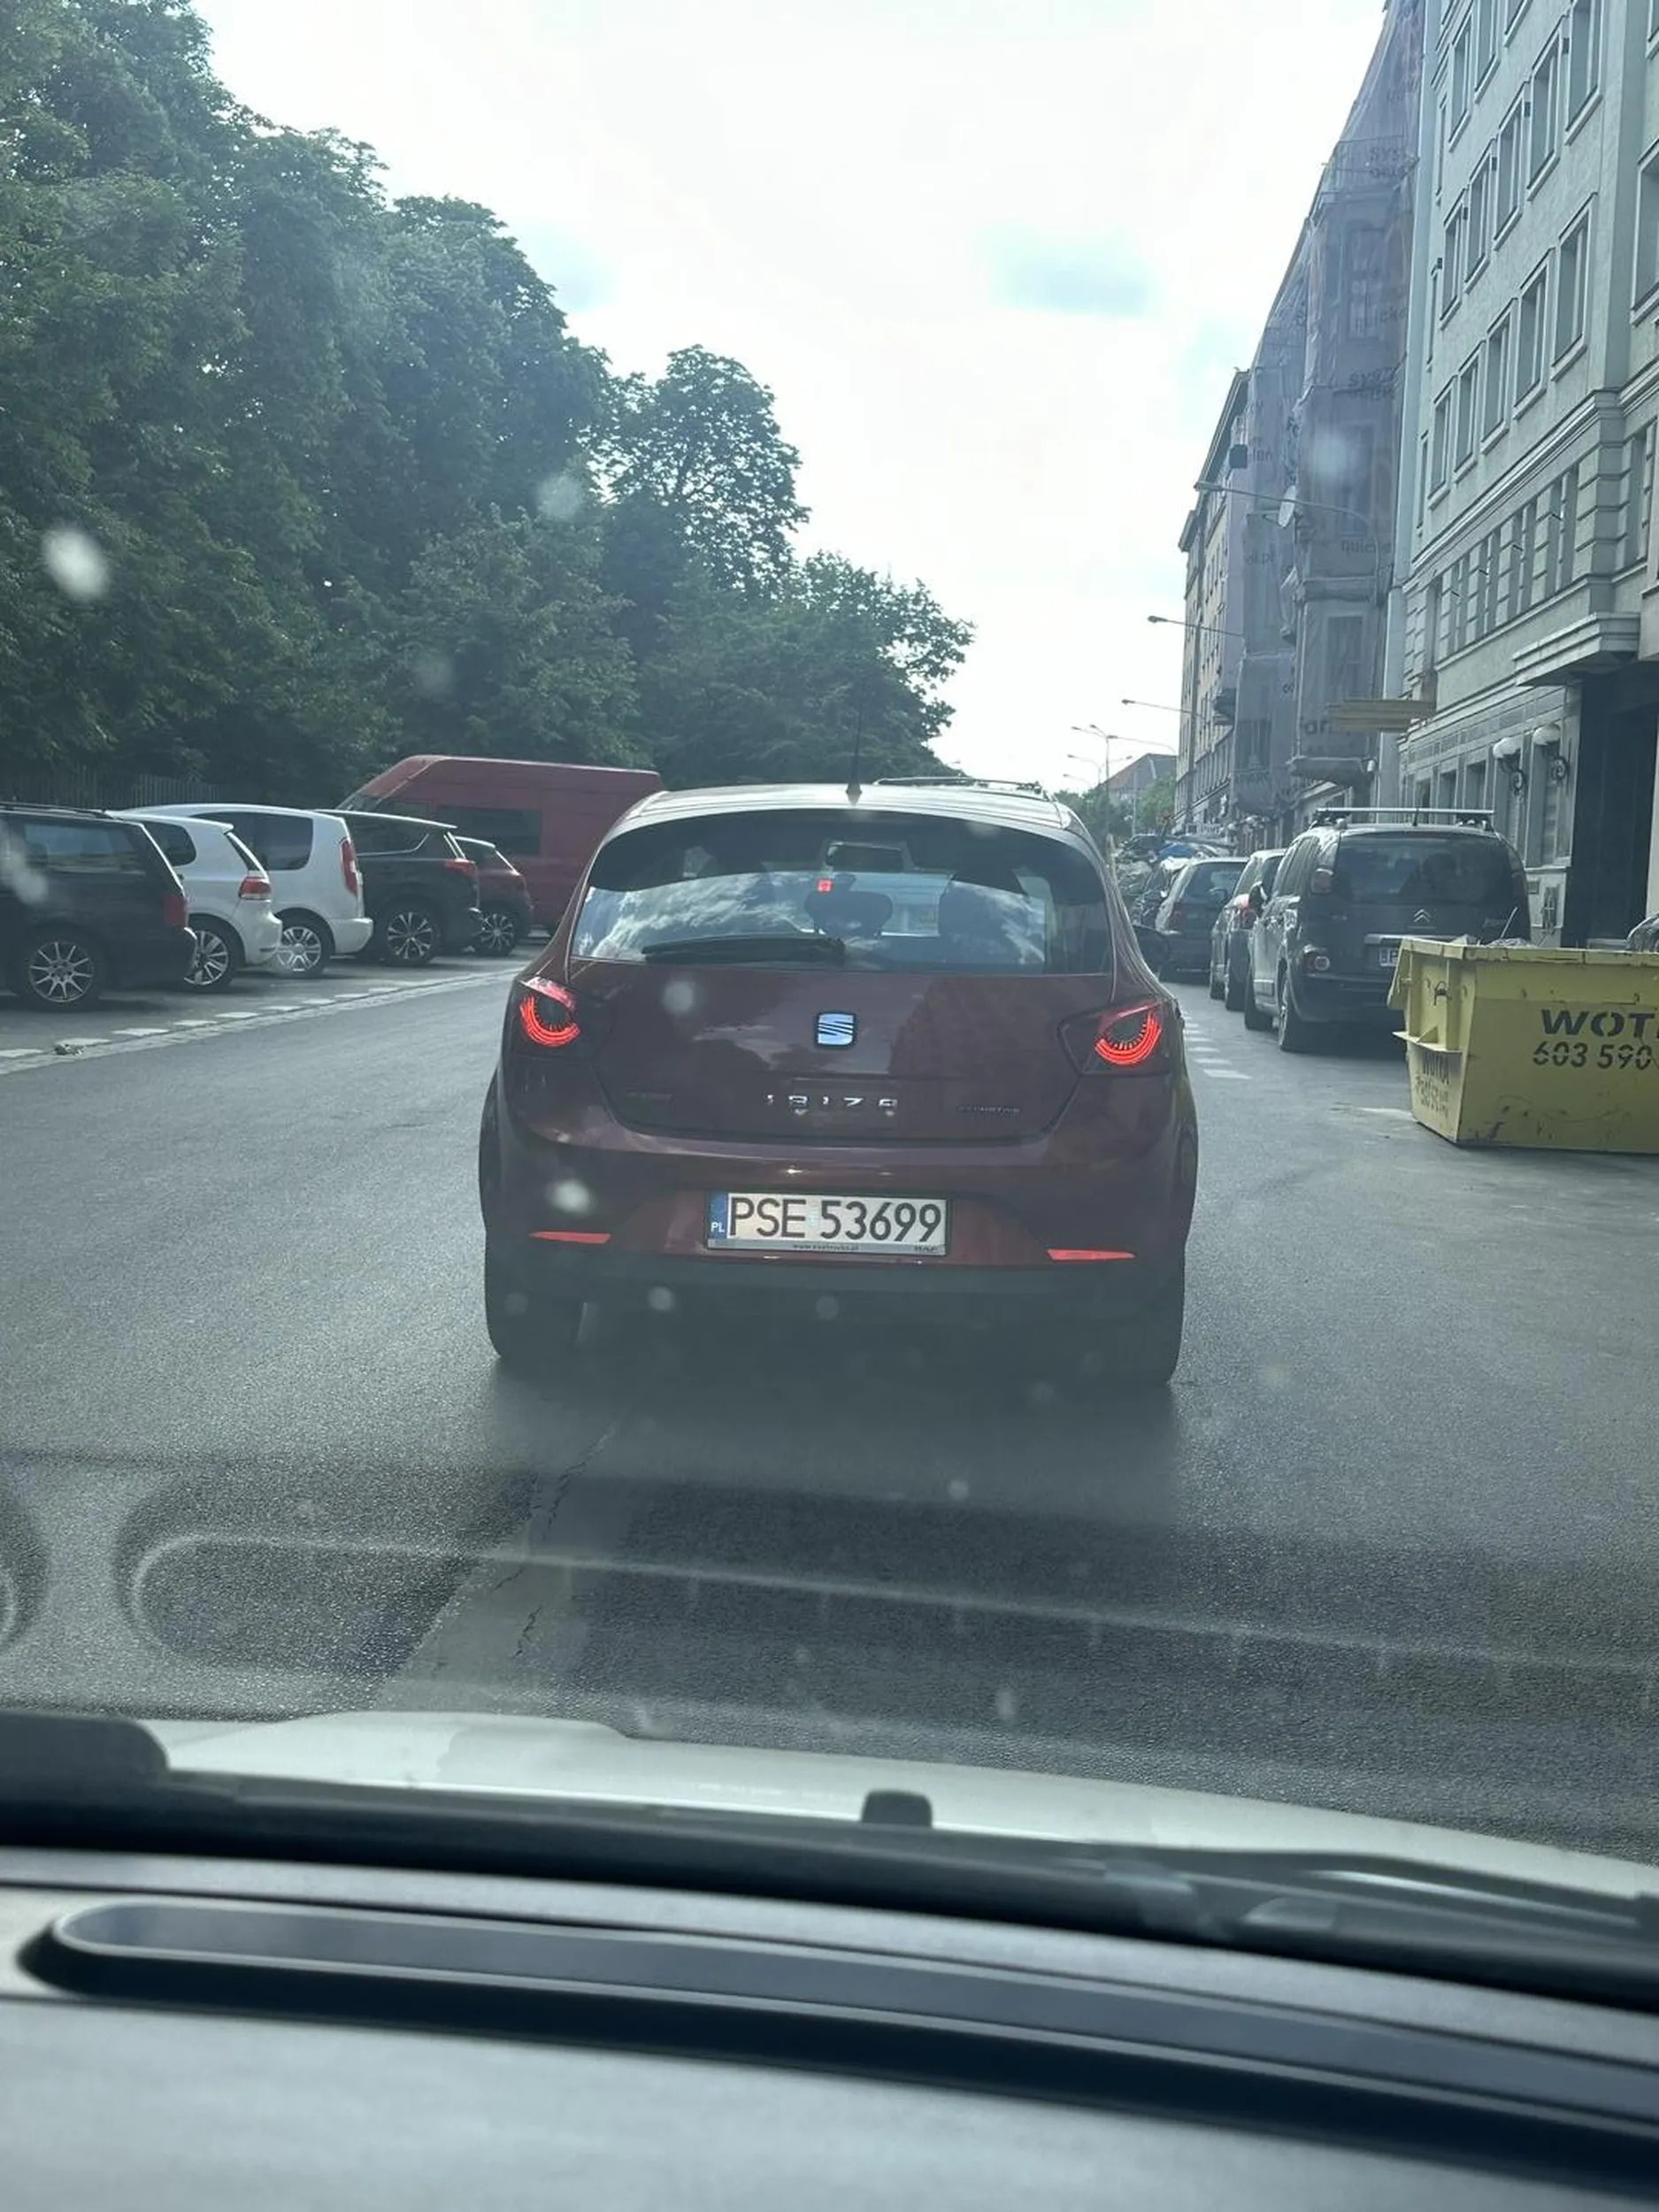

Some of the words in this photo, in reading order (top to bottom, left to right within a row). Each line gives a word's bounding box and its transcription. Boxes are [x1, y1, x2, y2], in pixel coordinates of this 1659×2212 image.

[1541, 1009, 1659, 1038] WOT
[1532, 1041, 1588, 1067] 603
[1596, 1044, 1653, 1071] 590
[710, 1222, 726, 1233] PL
[730, 1197, 807, 1239] PSE
[819, 1200, 942, 1242] 53699
